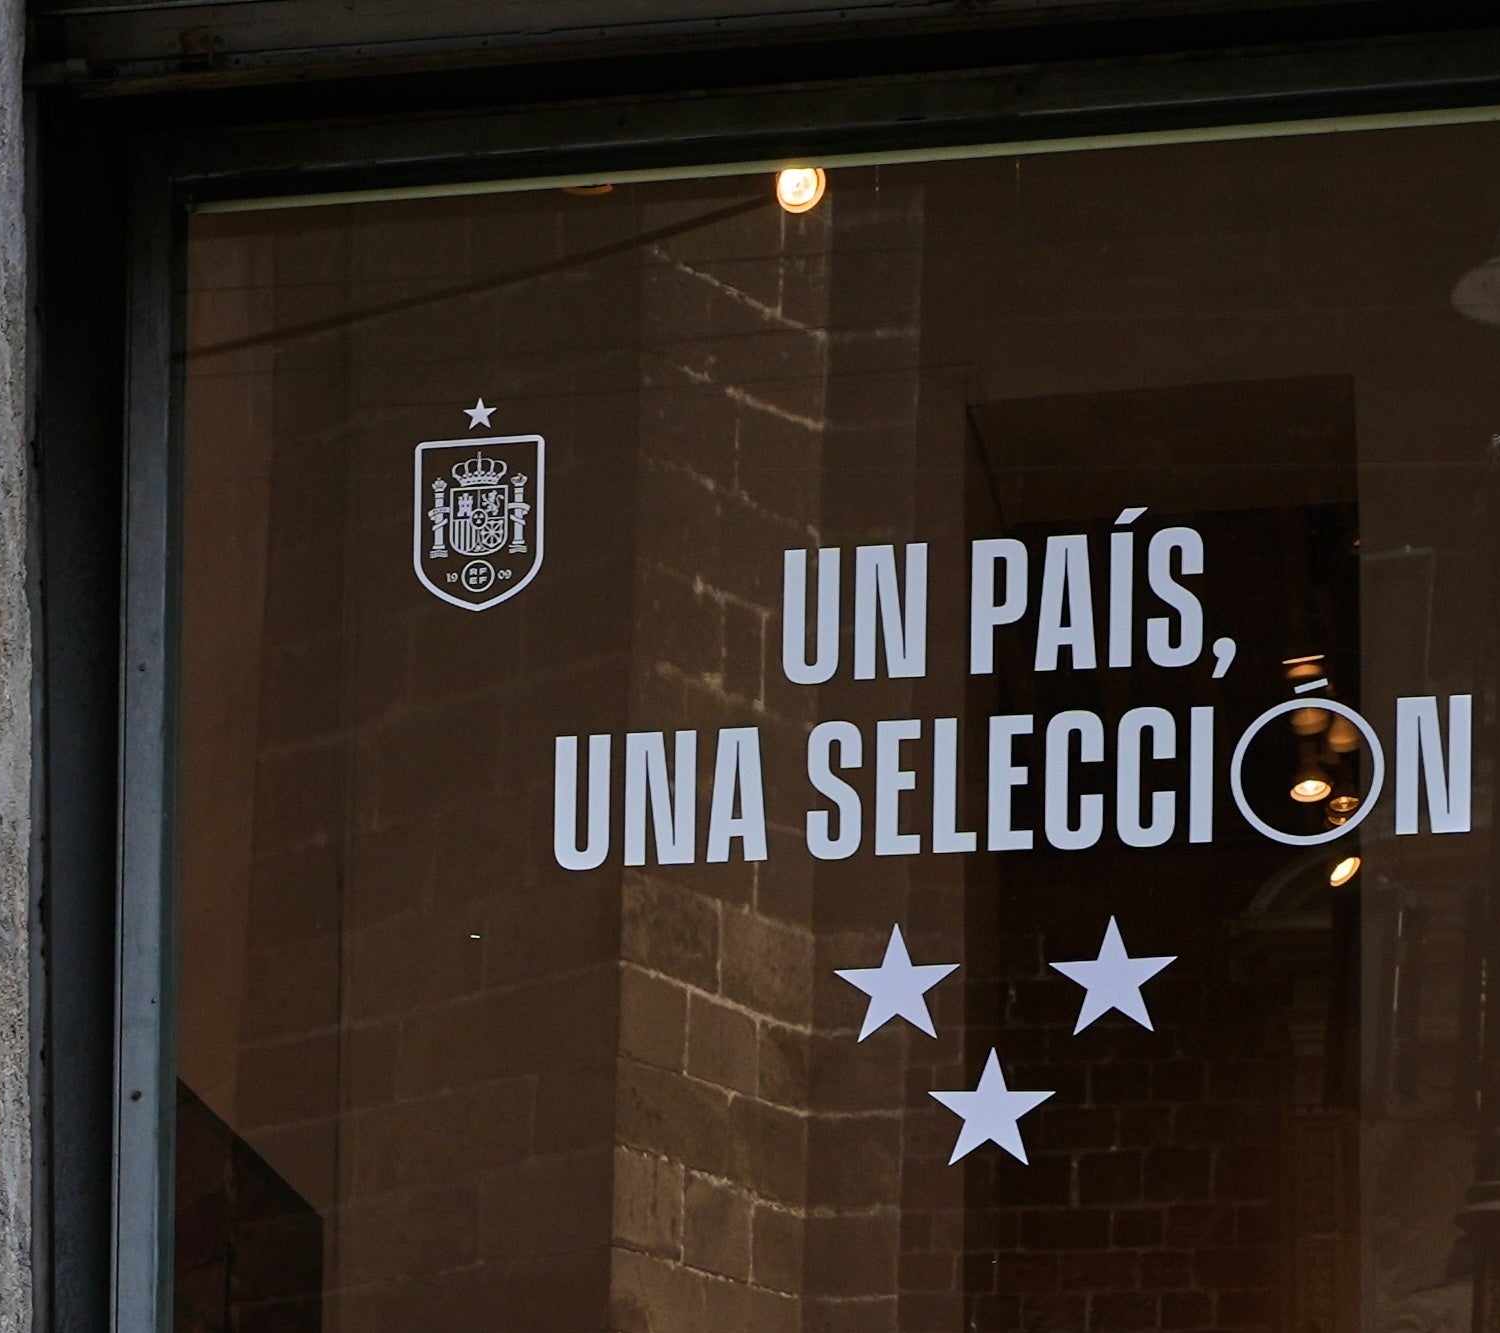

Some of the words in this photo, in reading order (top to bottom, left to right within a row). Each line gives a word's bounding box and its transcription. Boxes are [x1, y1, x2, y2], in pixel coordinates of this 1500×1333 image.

[446, 572, 459, 583] 19
[781, 542, 929, 686] UN
[969, 507, 1238, 680] PAÍS,
[554, 726, 768, 871] UNA
[806, 677, 1473, 861] SELECCIÓN
